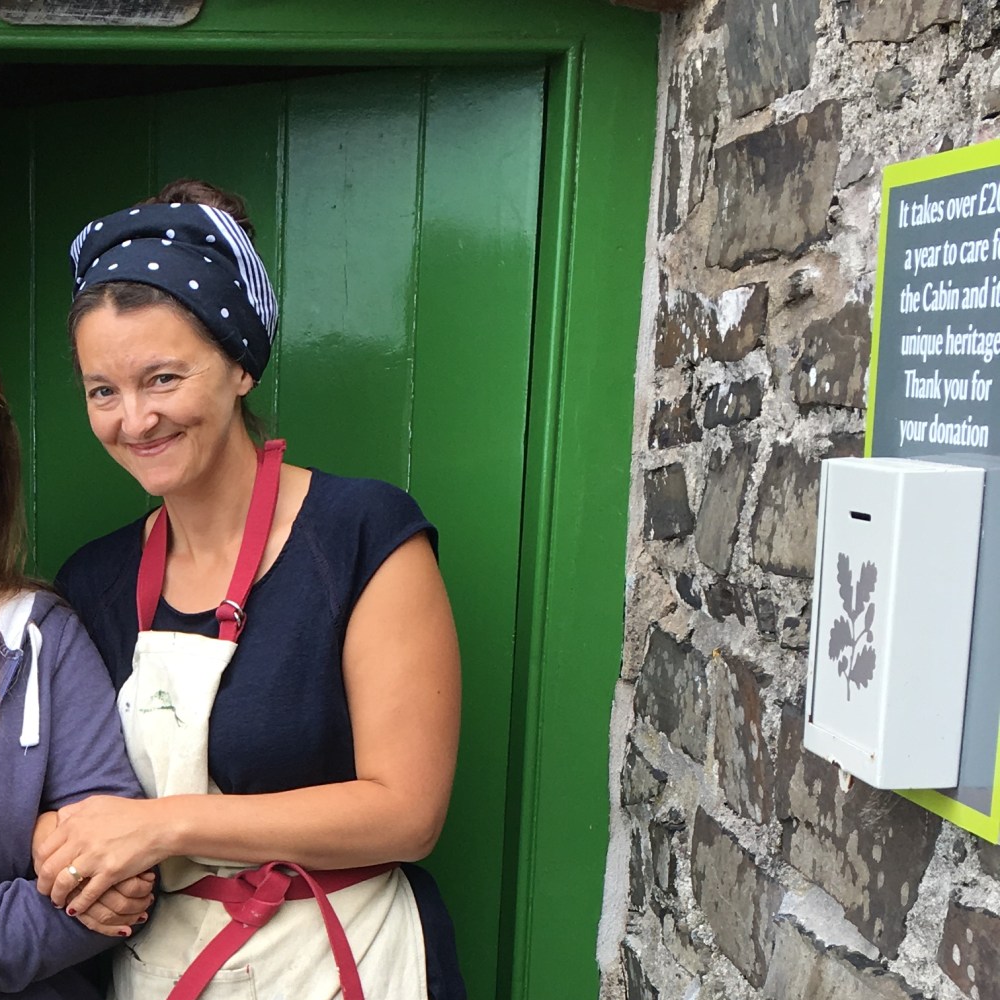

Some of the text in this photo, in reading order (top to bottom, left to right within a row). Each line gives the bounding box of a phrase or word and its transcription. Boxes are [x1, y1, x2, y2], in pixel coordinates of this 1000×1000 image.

[899, 200, 910, 228] It
[911, 194, 945, 227] takes
[946, 194, 978, 221] over
[904, 228, 1000, 277] a year to care f
[900, 283, 920, 314] the
[922, 279, 960, 312] Cabin
[961, 276, 989, 310] and
[901, 323, 1000, 363] unique heritage
[904, 369, 993, 408] Thank you for
[900, 413, 989, 448] your donation
